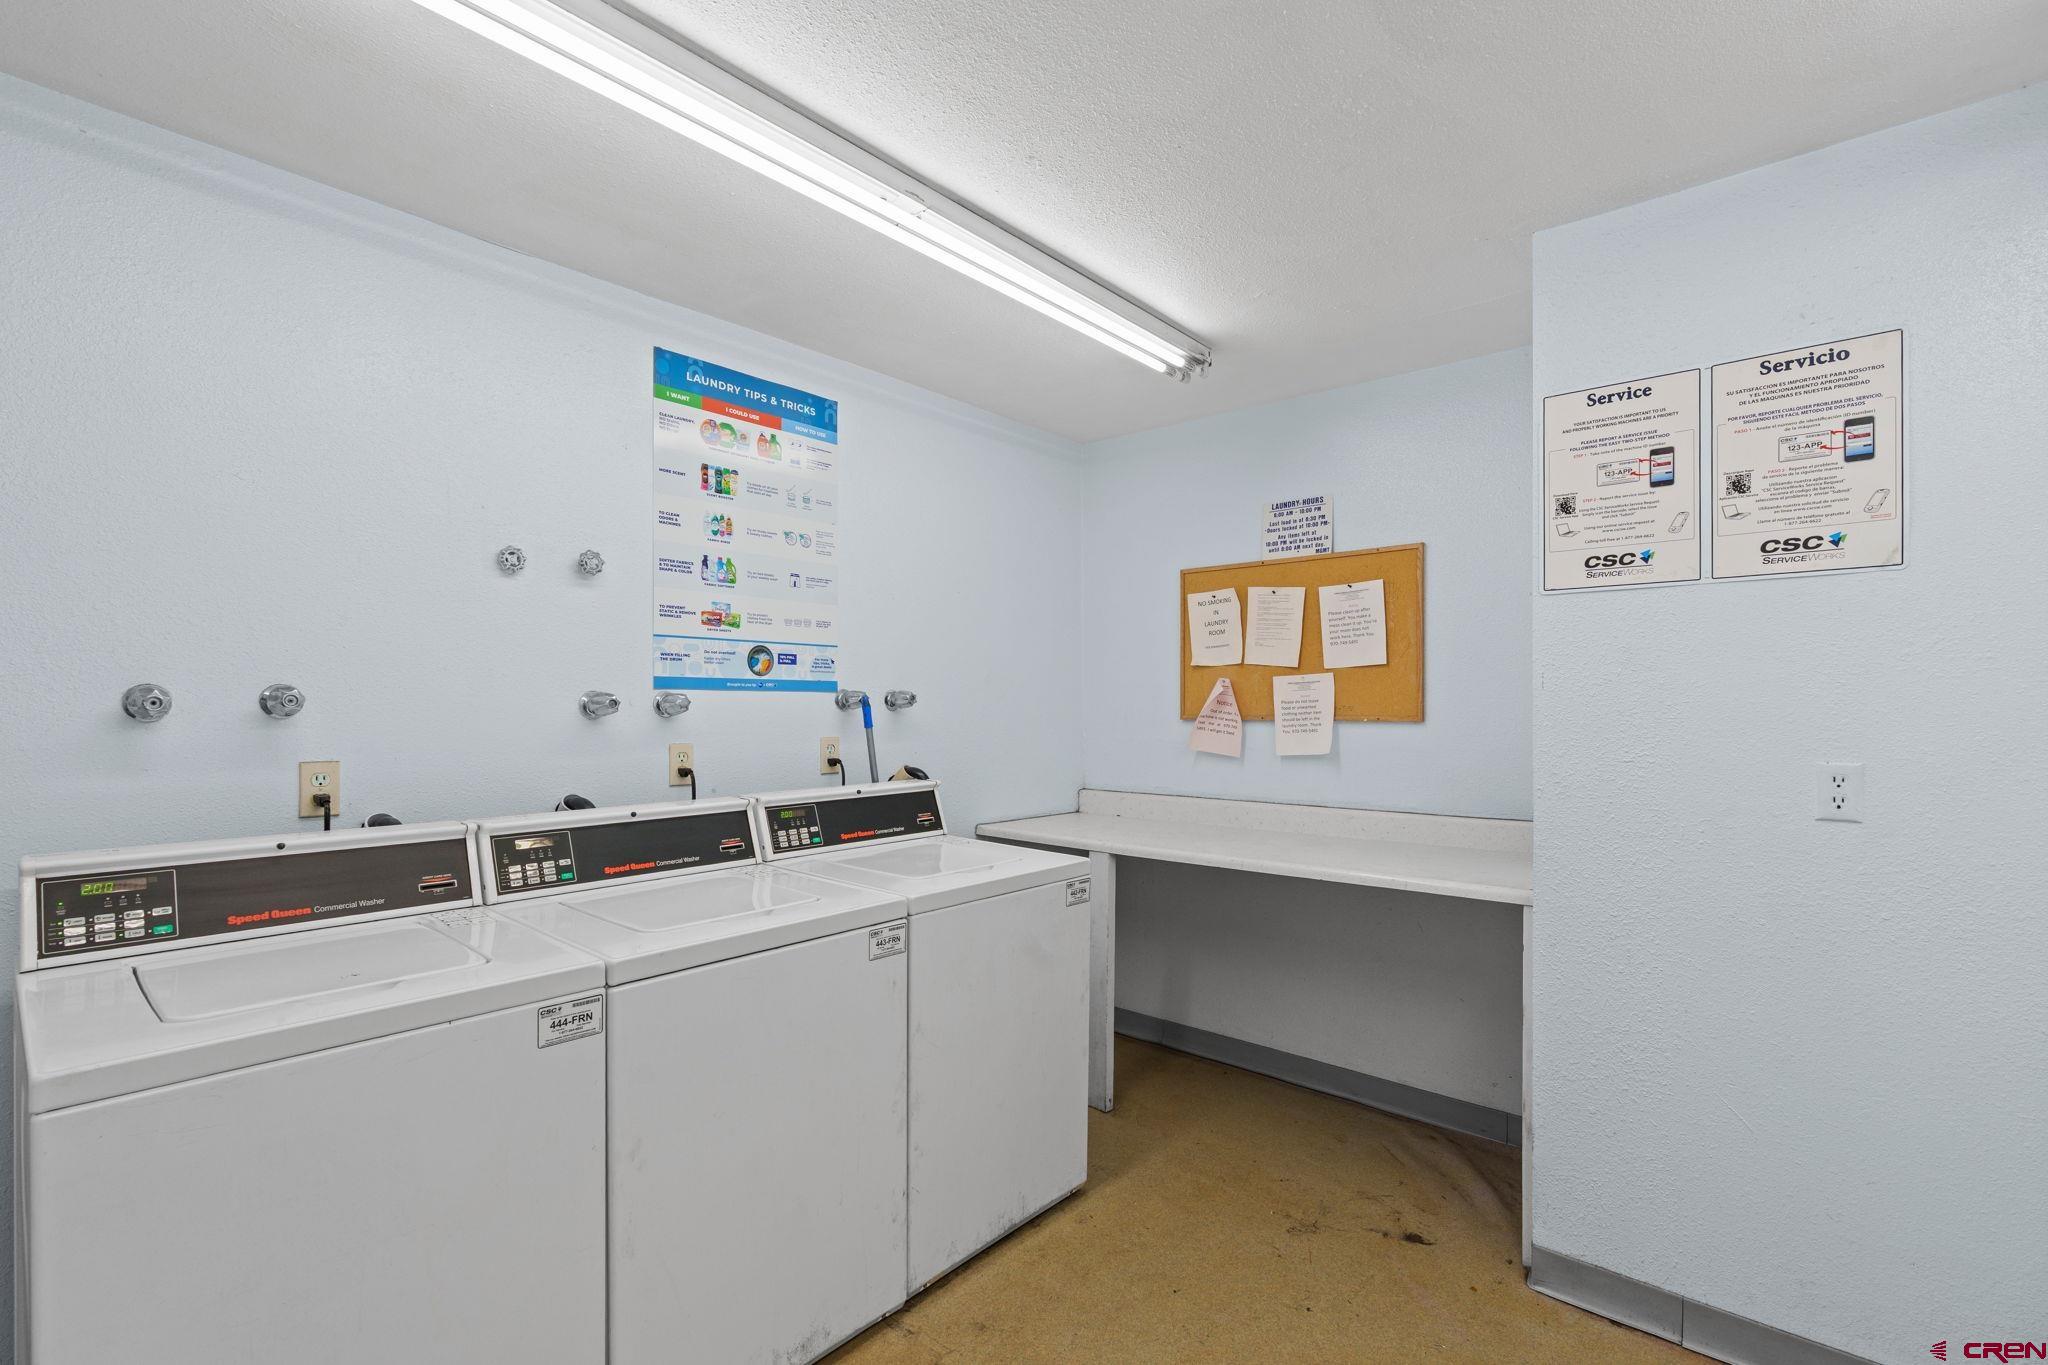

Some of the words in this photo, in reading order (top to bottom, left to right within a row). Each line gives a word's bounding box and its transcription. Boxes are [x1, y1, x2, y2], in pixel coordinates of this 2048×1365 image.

[1760, 348, 1850, 375] Servicio
[1734, 383, 1778, 395] SATISFACCION
[1788, 374, 1828, 385] IMPORTANTE
[1830, 370, 1846, 378] PARA
[1848, 364, 1884, 375] NOSOTROS
[1763, 382, 1818, 396] FUNCIONAMIENTO
[1820, 375, 1858, 386] APROPIADO
[671, 392, 690, 402] WANT
[687, 372, 740, 394] LAUNDRY
[744, 389, 767, 402] TIPS
[771, 397, 777, 405] &
[780, 399, 816, 415] TRICKS
[1587, 387, 1652, 407] Service
[1761, 392, 1793, 402] MAQUINAS
[1803, 386, 1832, 395] NUESTRA
[1834, 379, 1870, 390] PRIORIDAD
[729, 408, 748, 417] COULD
[1758, 409, 1780, 417] REPORTE
[1782, 404, 1812, 413] CUALQUIER
[1813, 399, 1843, 408] PROBLEMA
[1587, 415, 1618, 424] SATISFACTION
[1624, 410, 1651, 419] IMPORTANT
[1596, 421, 1617, 429] WORKING
[1619, 417, 1642, 425] MACHINES
[1657, 411, 1679, 419] PRIORITY
[795, 425, 808, 433] HOW
[1570, 444, 1597, 452] FOLLOWING
[1788, 442, 1822, 451] 123-APP
[1272, 500, 1299, 510] LAUNDRY
[1303, 497, 1323, 505] HOURS
[1760, 536, 1824, 553] CSC
[1585, 553, 1636, 568] CSC
[1208, 597, 1231, 606] SMOKING
[1205, 619, 1228, 627] LAUNDRY
[604, 865, 629, 874] Speed
[631, 862, 655, 870] Queen
[656, 858, 682, 866] Commercial
[228, 913, 269, 925] Speed
[271, 908, 311, 918] Queen
[314, 902, 357, 913] Commercial
[360, 898, 385, 907] Washer
[876, 936, 900, 946] 443-FRN
[550, 1012, 592, 1029] 444-FRN
